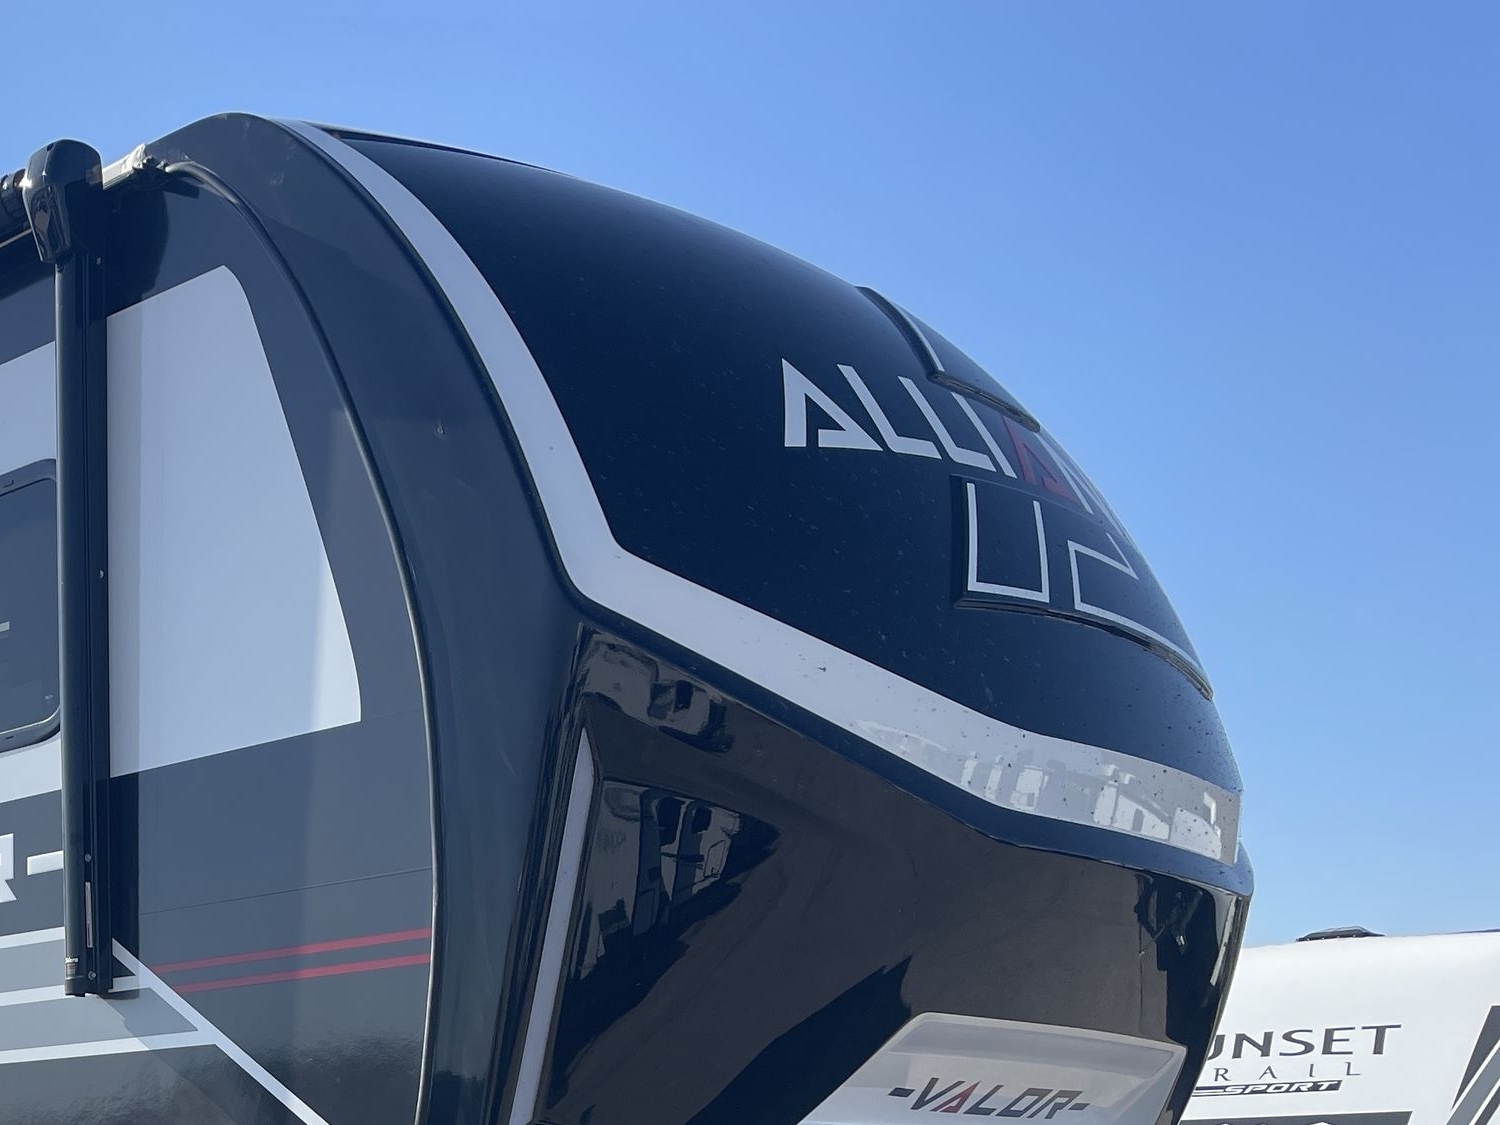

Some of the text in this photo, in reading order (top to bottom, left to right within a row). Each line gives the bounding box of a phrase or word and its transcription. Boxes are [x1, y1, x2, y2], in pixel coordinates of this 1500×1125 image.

[781, 357, 1132, 540] ALLIAN
[1206, 1024, 1402, 1061] NSET
[1213, 1061, 1361, 1082] RAIL
[1222, 1080, 1339, 1095] SPORT
